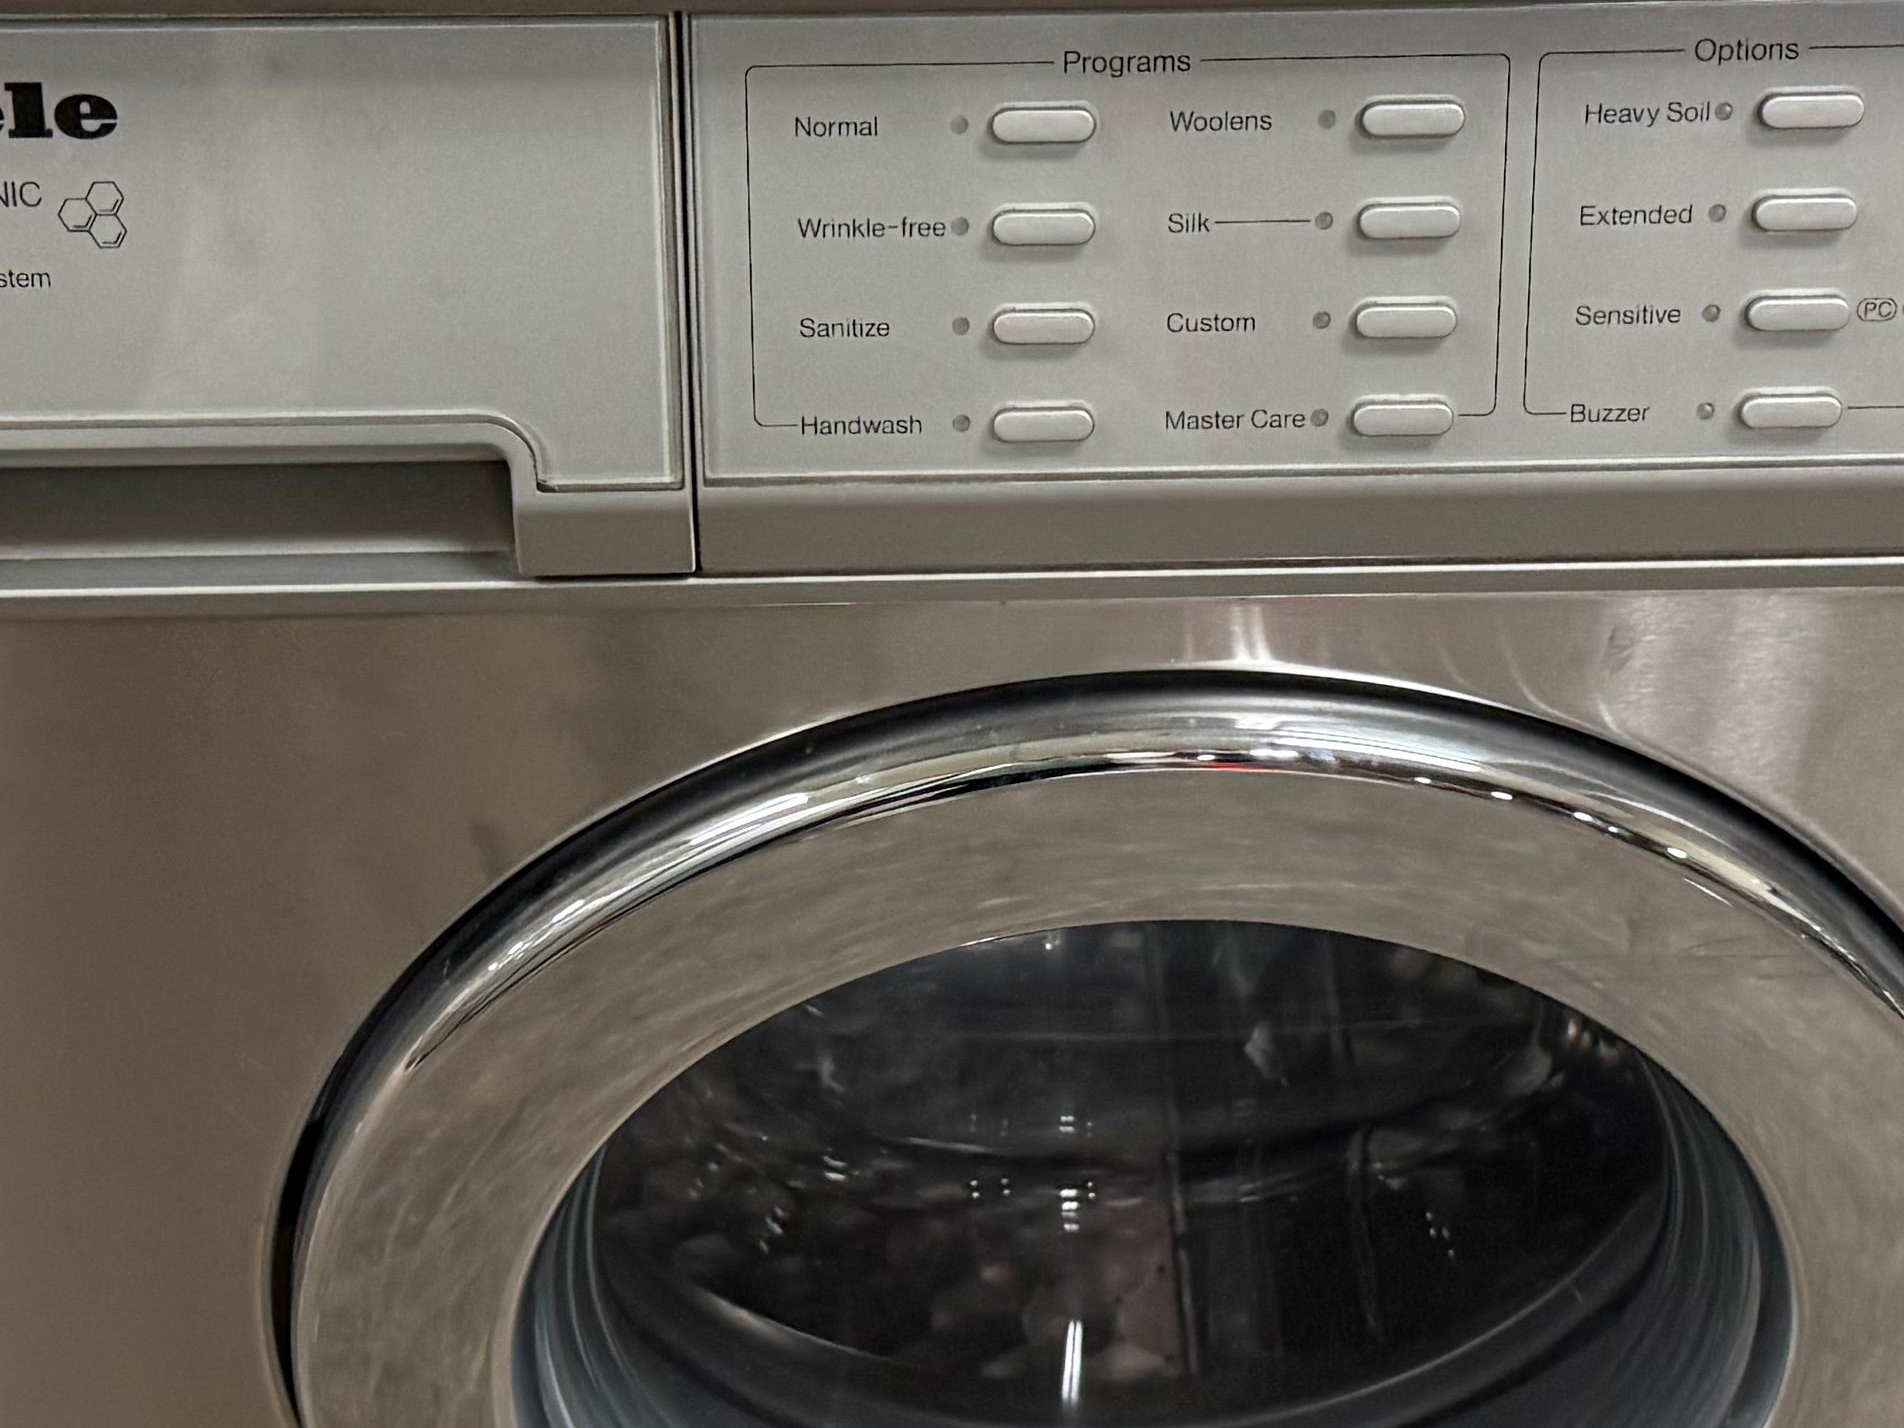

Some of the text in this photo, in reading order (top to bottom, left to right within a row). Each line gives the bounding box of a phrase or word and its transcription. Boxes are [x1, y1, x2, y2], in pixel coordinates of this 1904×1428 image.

[1695, 38, 1800, 65] Options
[1063, 51, 1191, 78] Programs
[1169, 110, 1273, 132] Woolens
[1585, 102, 1711, 128] Heavy Soil
[794, 116, 879, 138] Normal
[1167, 211, 1212, 235] Silk
[1579, 204, 1693, 226] Extended
[798, 216, 947, 239] Wrinkle-free
[1575, 305, 1682, 327] Sensitive
[1863, 300, 1894, 319] PC
[799, 317, 890, 339] Sanitize
[1165, 313, 1257, 334] Custom
[1165, 408, 1307, 432] Master Care
[1570, 404, 1650, 423] Buzzer
[800, 413, 924, 438] Handwash
